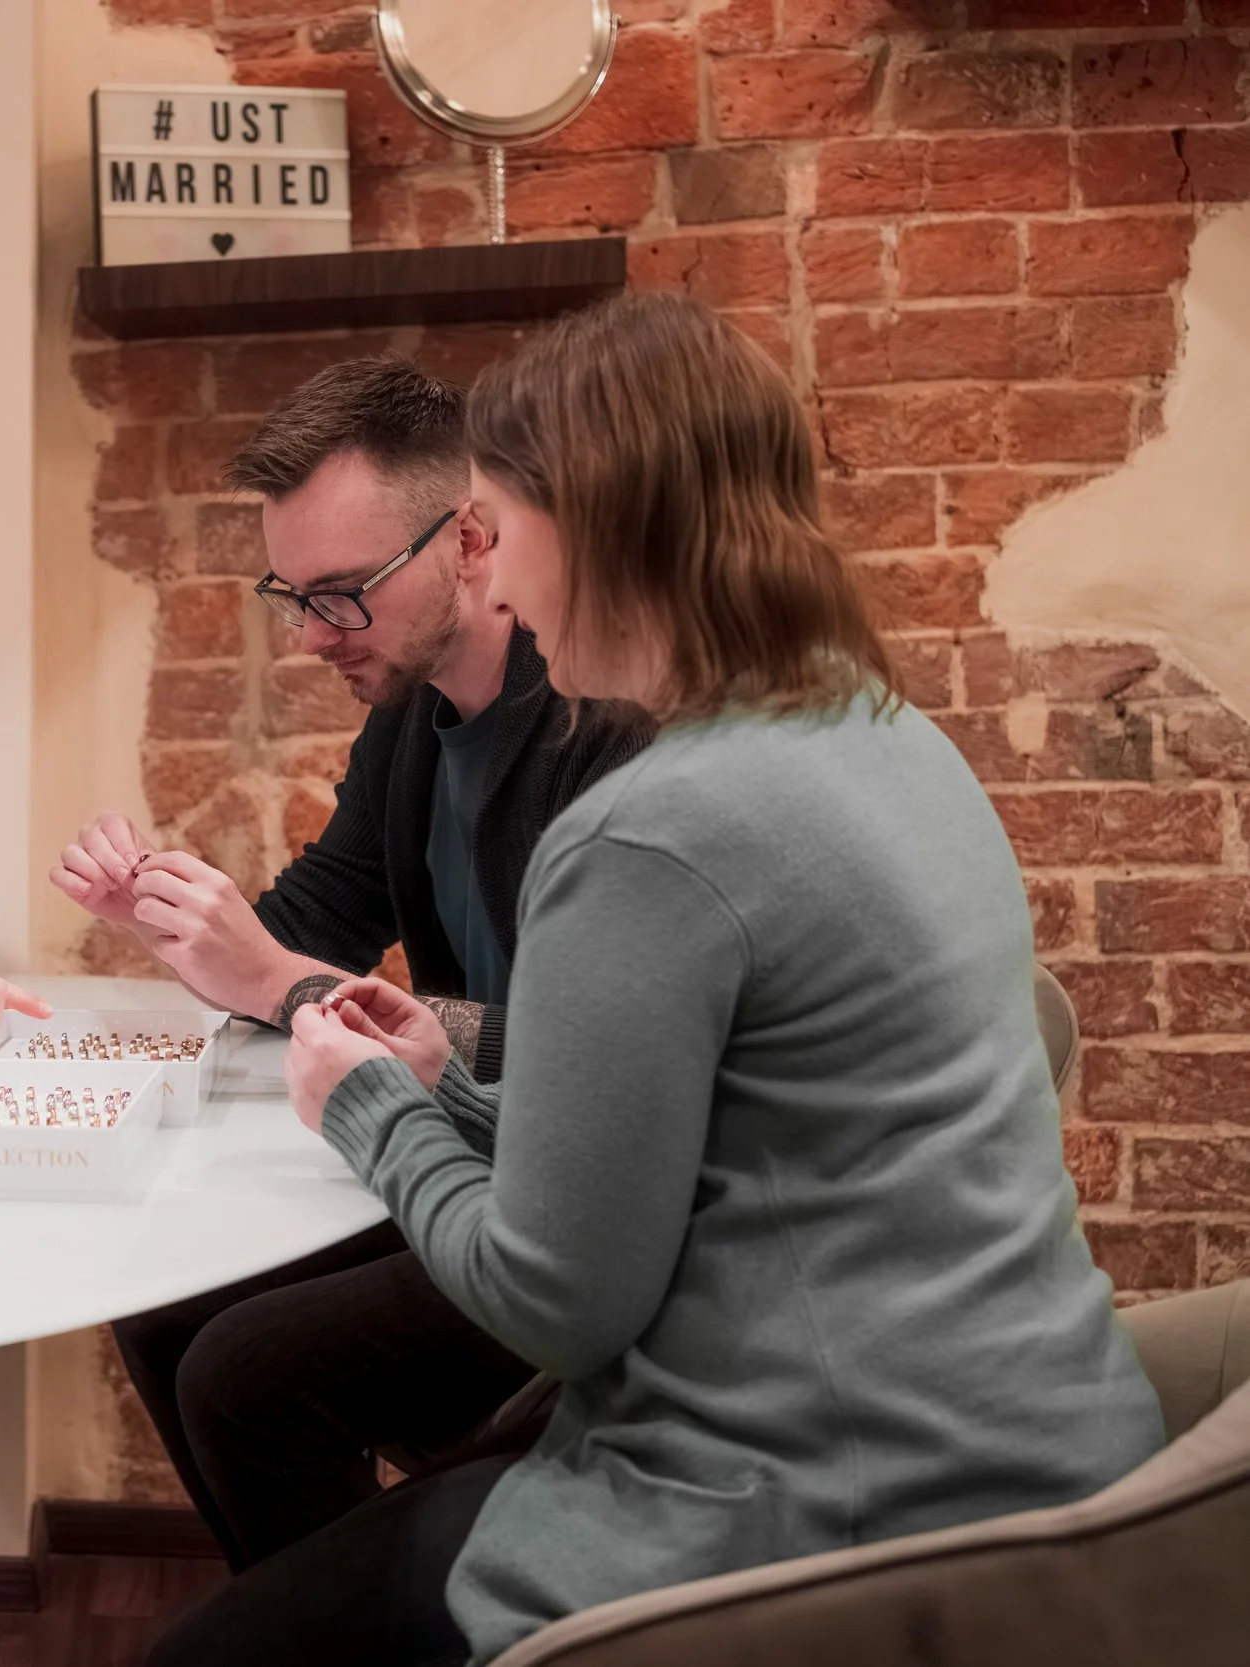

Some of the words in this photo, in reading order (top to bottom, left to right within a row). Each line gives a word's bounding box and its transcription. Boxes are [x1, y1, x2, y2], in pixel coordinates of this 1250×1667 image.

[153, 100, 175, 141] #
[211, 101, 289, 144] UST
[110, 161, 330, 205] MARRIED
